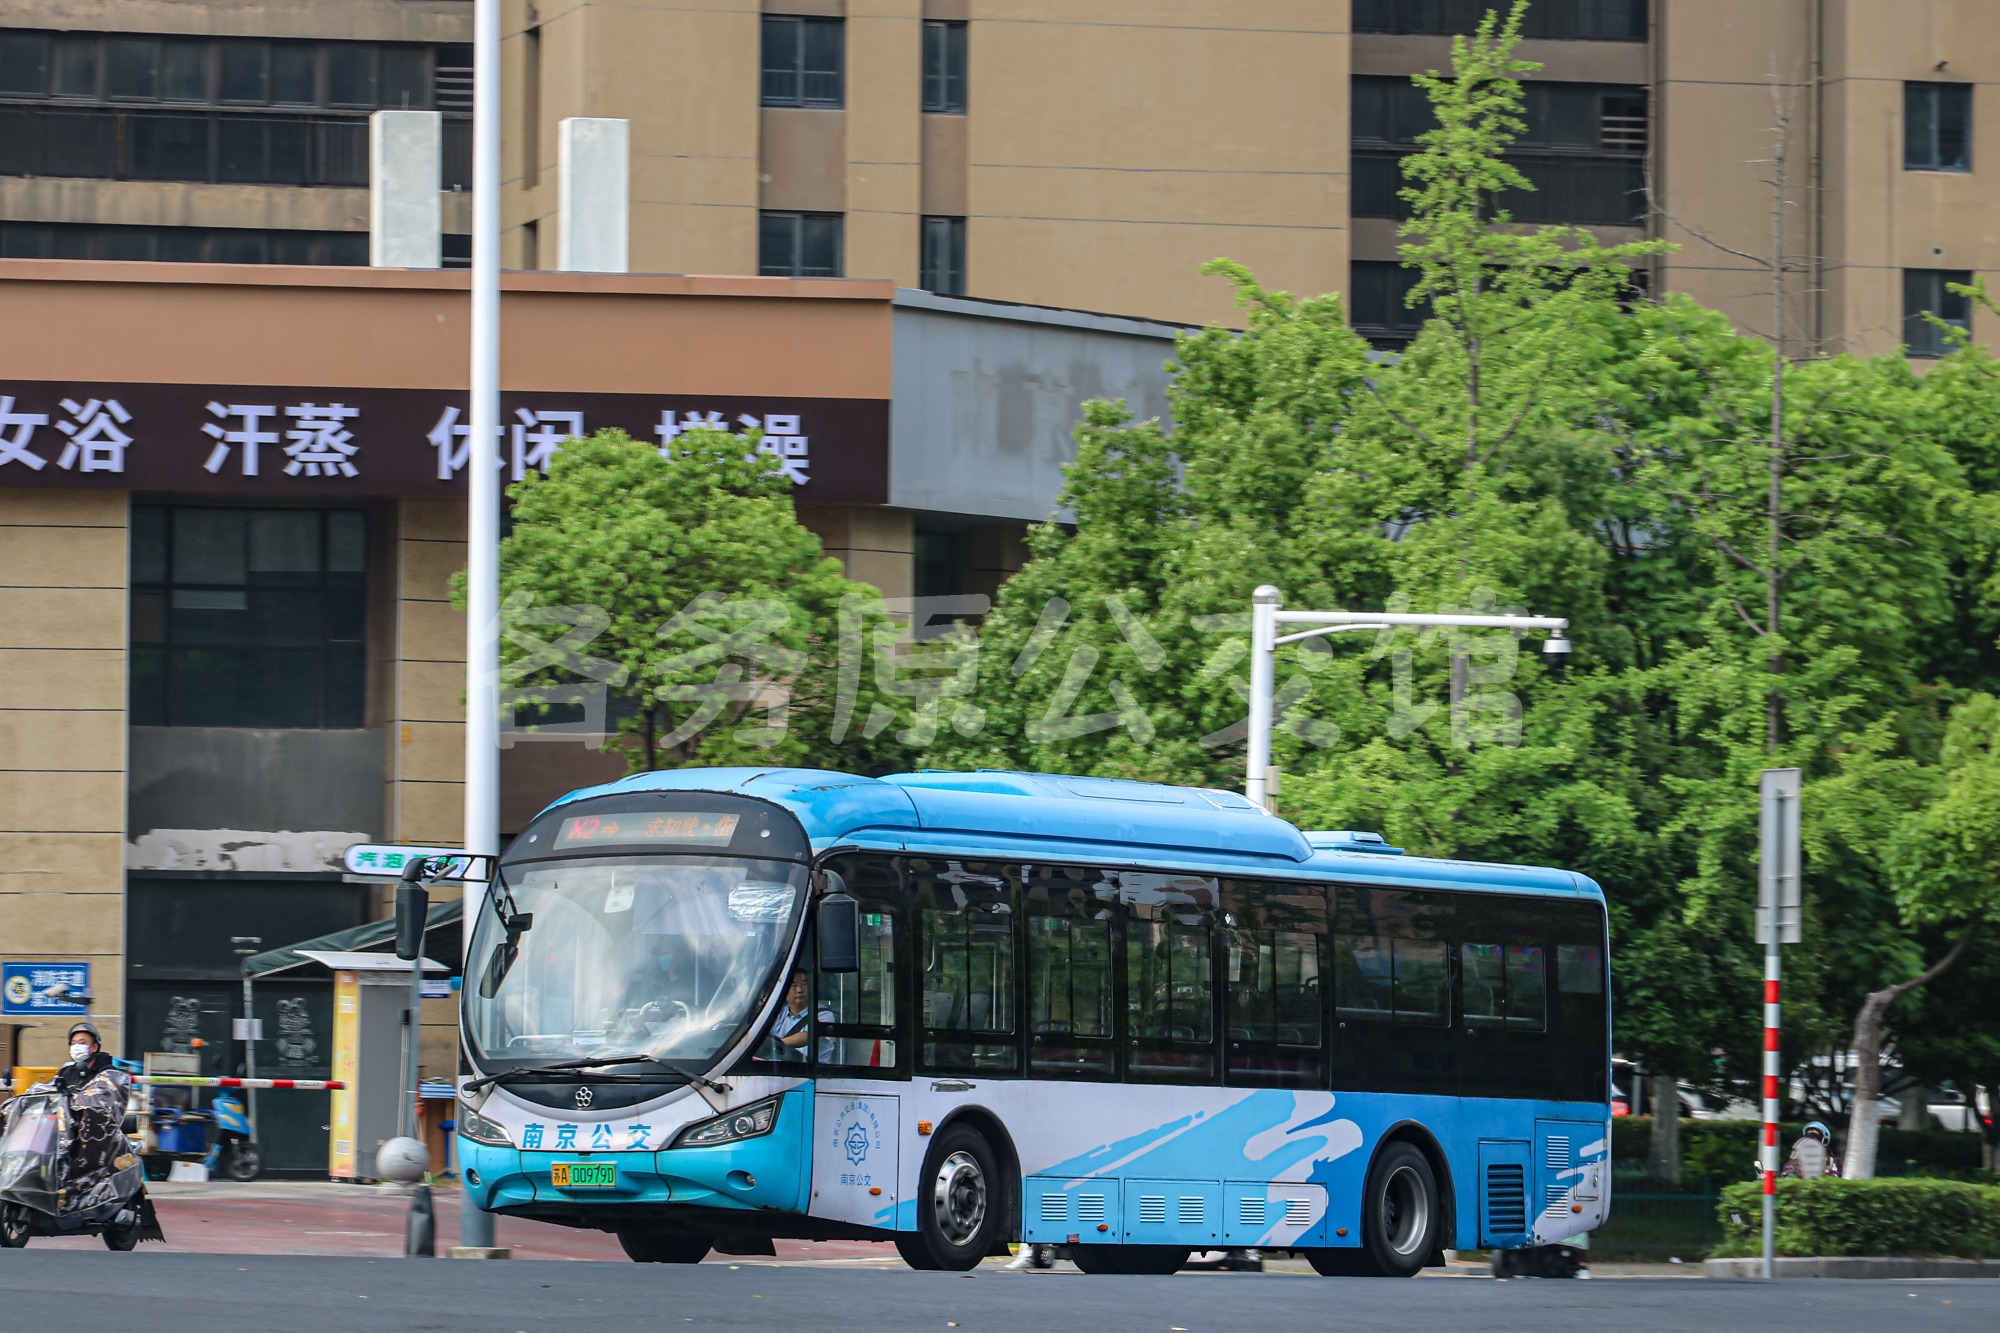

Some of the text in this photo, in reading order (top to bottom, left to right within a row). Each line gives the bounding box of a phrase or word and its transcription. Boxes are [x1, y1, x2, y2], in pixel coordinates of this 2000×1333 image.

[0, 394, 135, 473] 女浴
[200, 401, 361, 478] 汗蒸
[426, 405, 585, 482] 休闲
[522, 1123, 652, 1150] 南京公交
[840, 1174, 872, 1187] 南京公交
